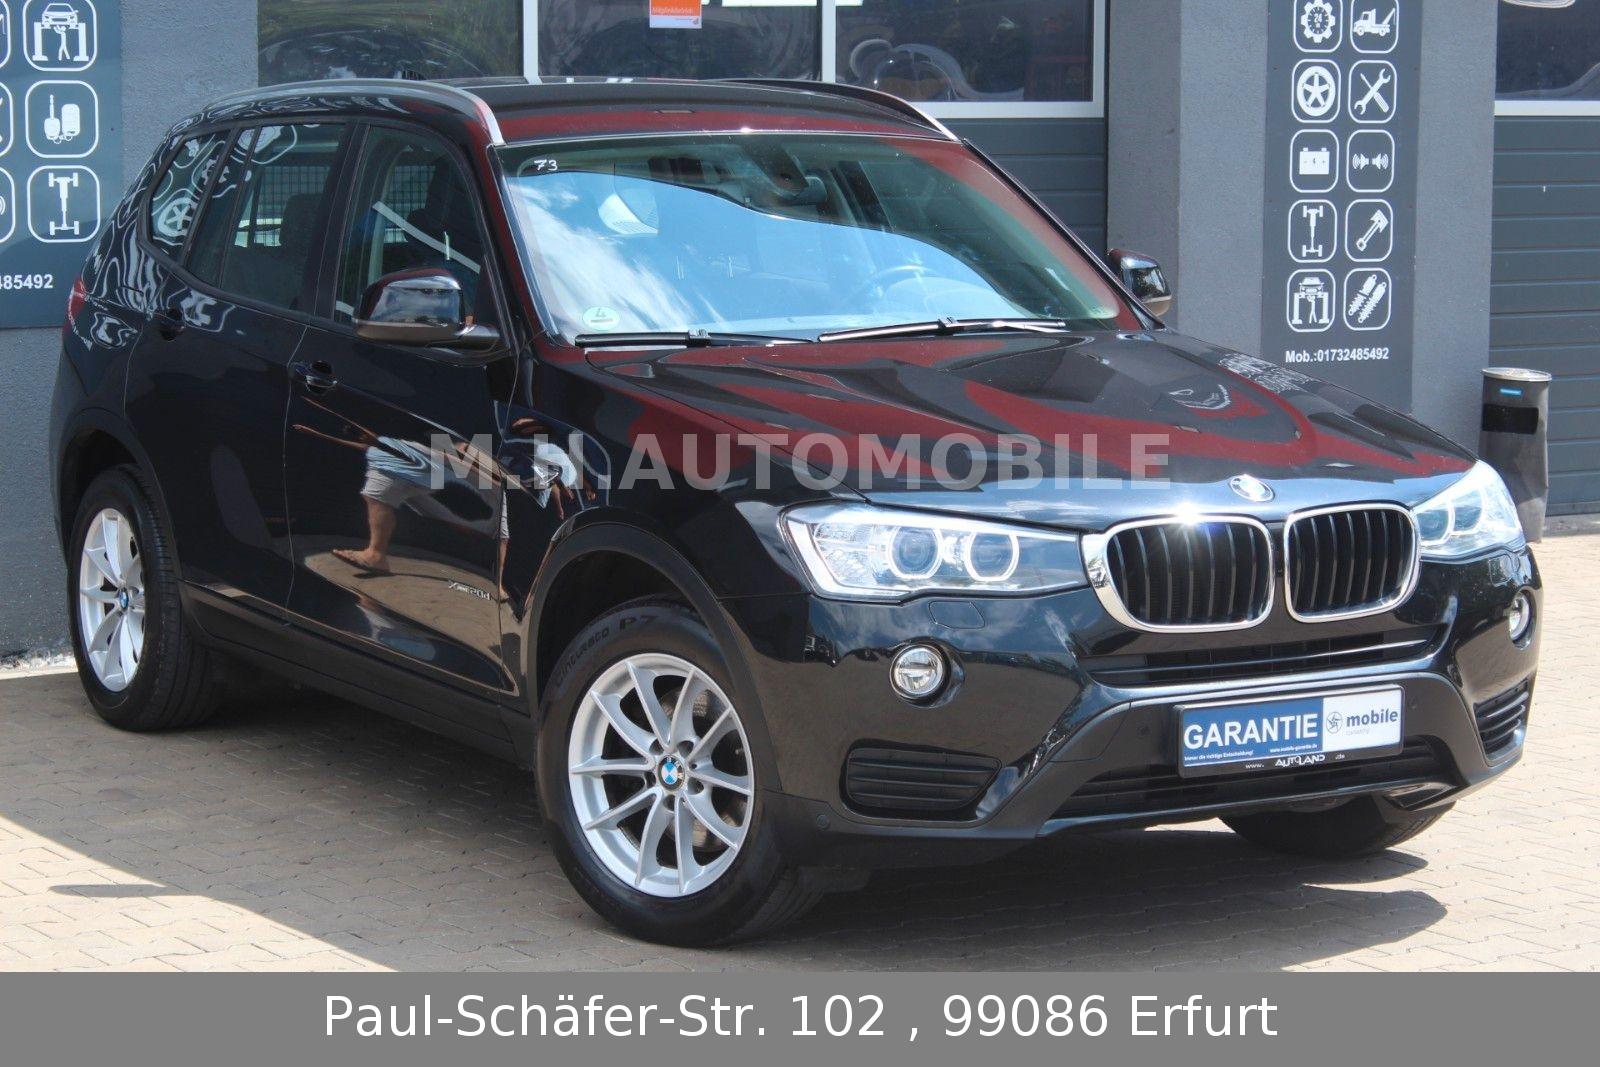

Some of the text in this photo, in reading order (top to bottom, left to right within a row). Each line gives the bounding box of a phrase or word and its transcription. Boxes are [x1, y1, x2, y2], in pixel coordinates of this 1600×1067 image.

[533, 159, 558, 171] 73
[0, 273, 54, 290] 85492
[1285, 346, 1390, 363] Mob.:01732485492
[1346, 708, 1399, 728] mobile
[1183, 713, 1319, 750] GARANTIE
